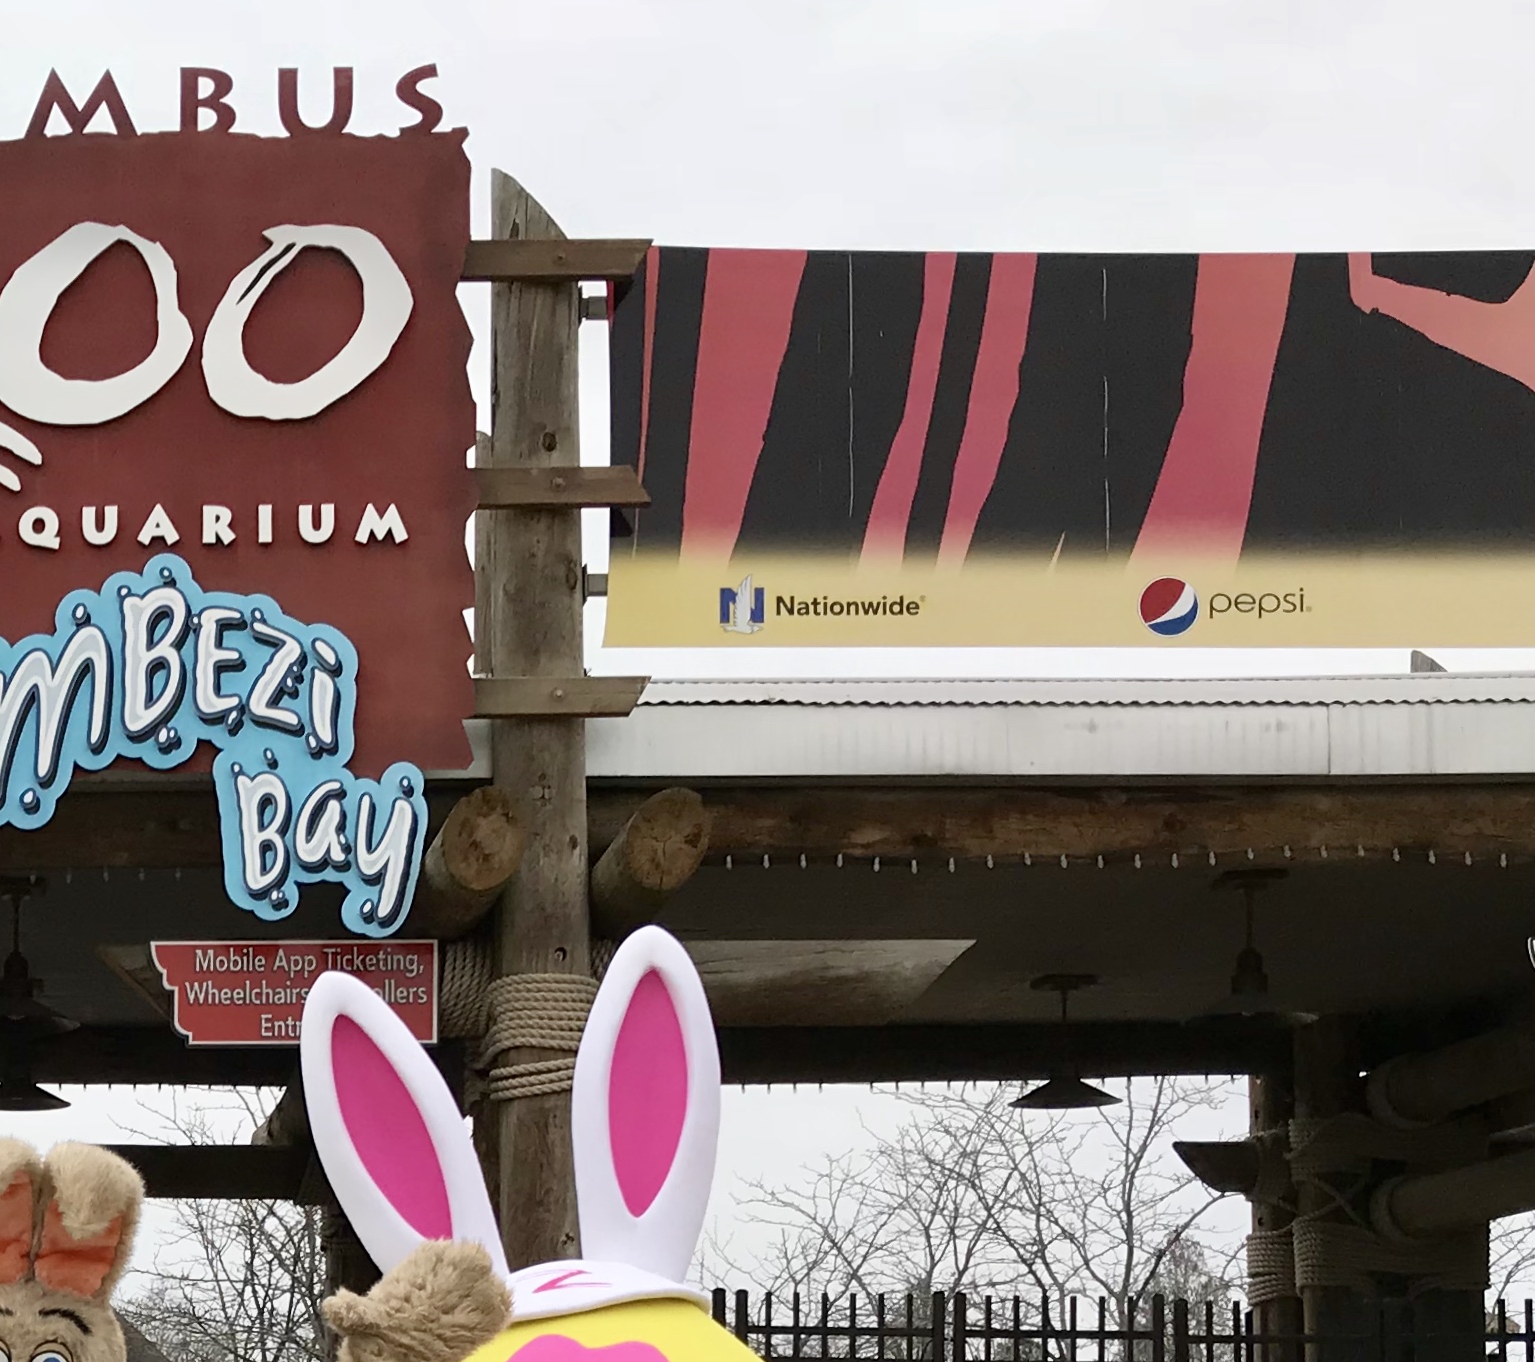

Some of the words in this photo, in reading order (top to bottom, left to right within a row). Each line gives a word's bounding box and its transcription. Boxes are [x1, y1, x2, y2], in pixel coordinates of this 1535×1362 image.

[775, 595, 921, 617] Nationwide
[1208, 587, 1305, 619] pepsi
[236, 772, 416, 921] Bay
[195, 947, 266, 973] Mobile
[273, 948, 316, 978] App
[322, 946, 425, 977] Ticketing,
